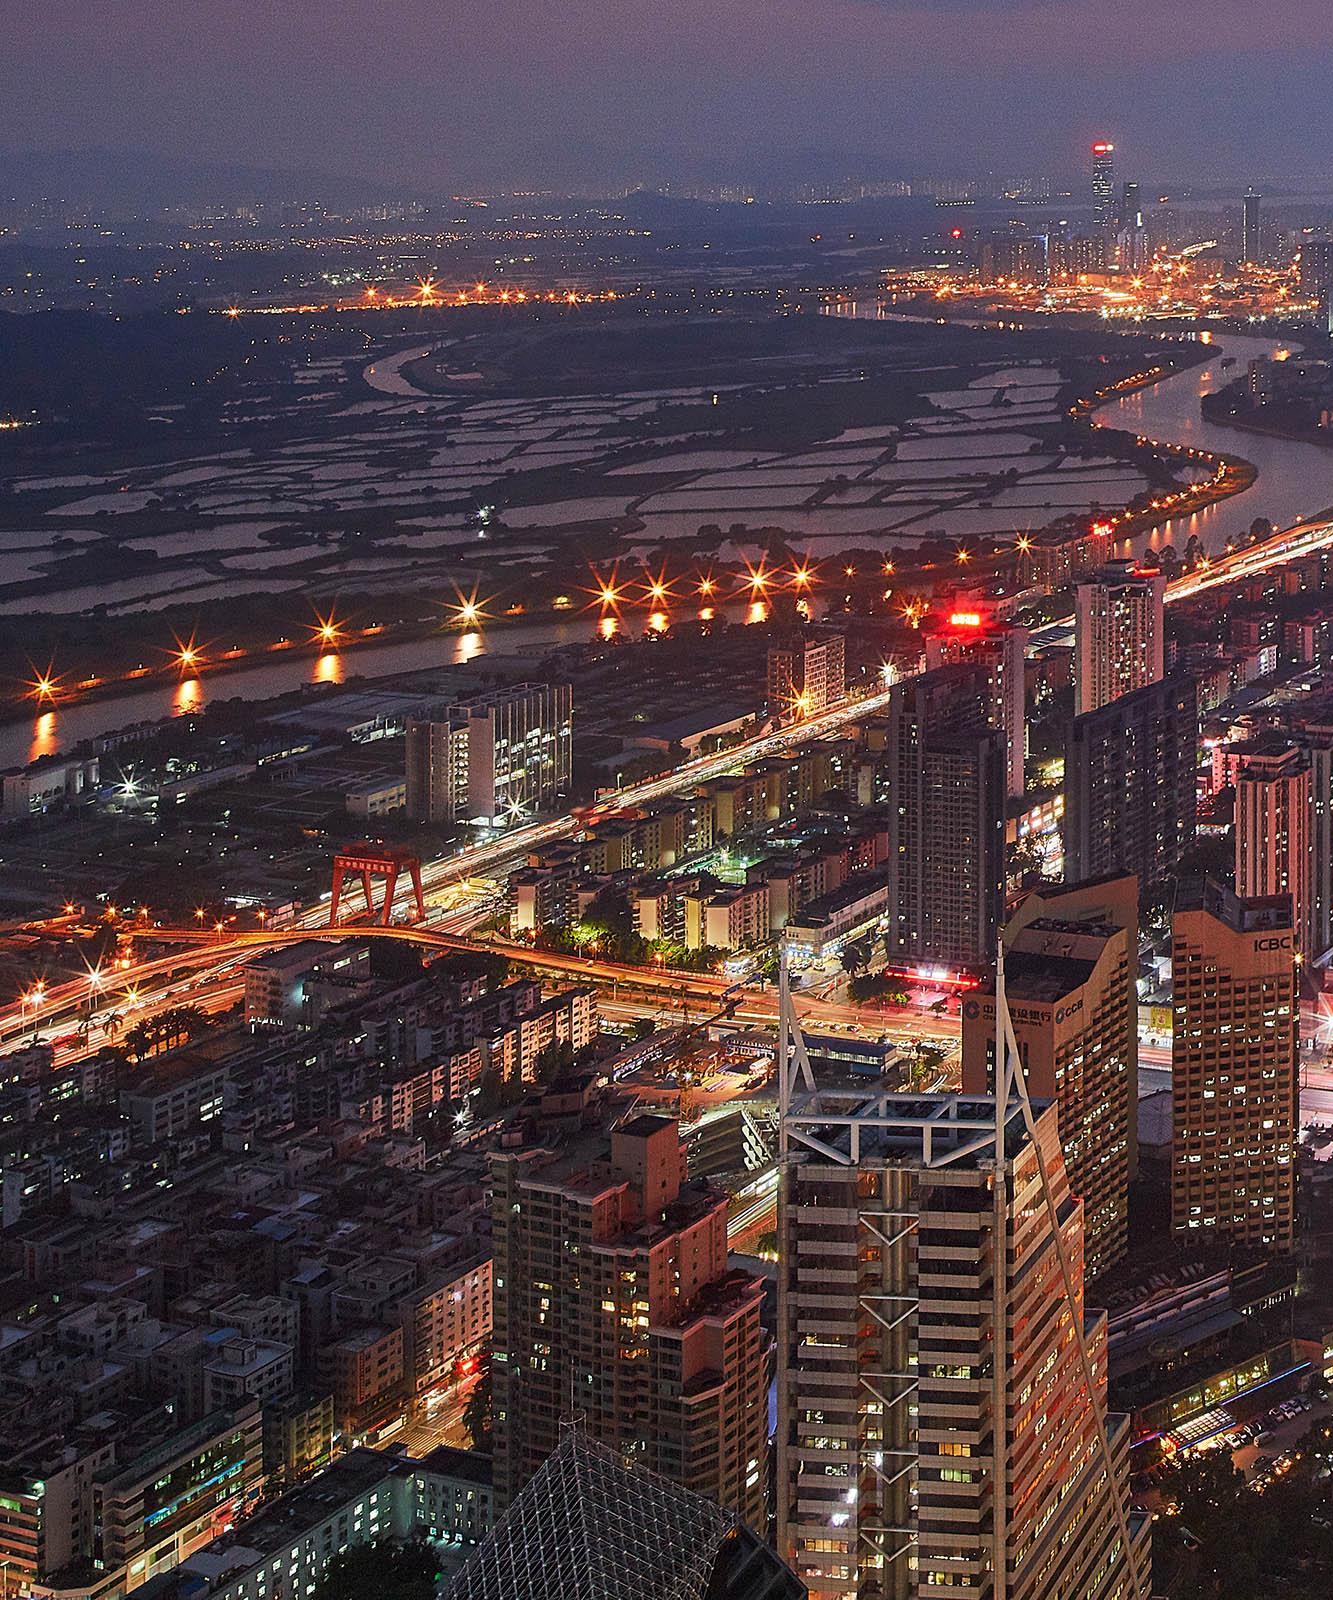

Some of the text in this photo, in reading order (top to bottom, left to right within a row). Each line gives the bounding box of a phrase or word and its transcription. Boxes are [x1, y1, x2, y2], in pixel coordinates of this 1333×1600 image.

[1254, 936, 1291, 952] ICBC
[983, 1004, 1052, 1022] 中建设银行
[1065, 1000, 1084, 1017] CCB
